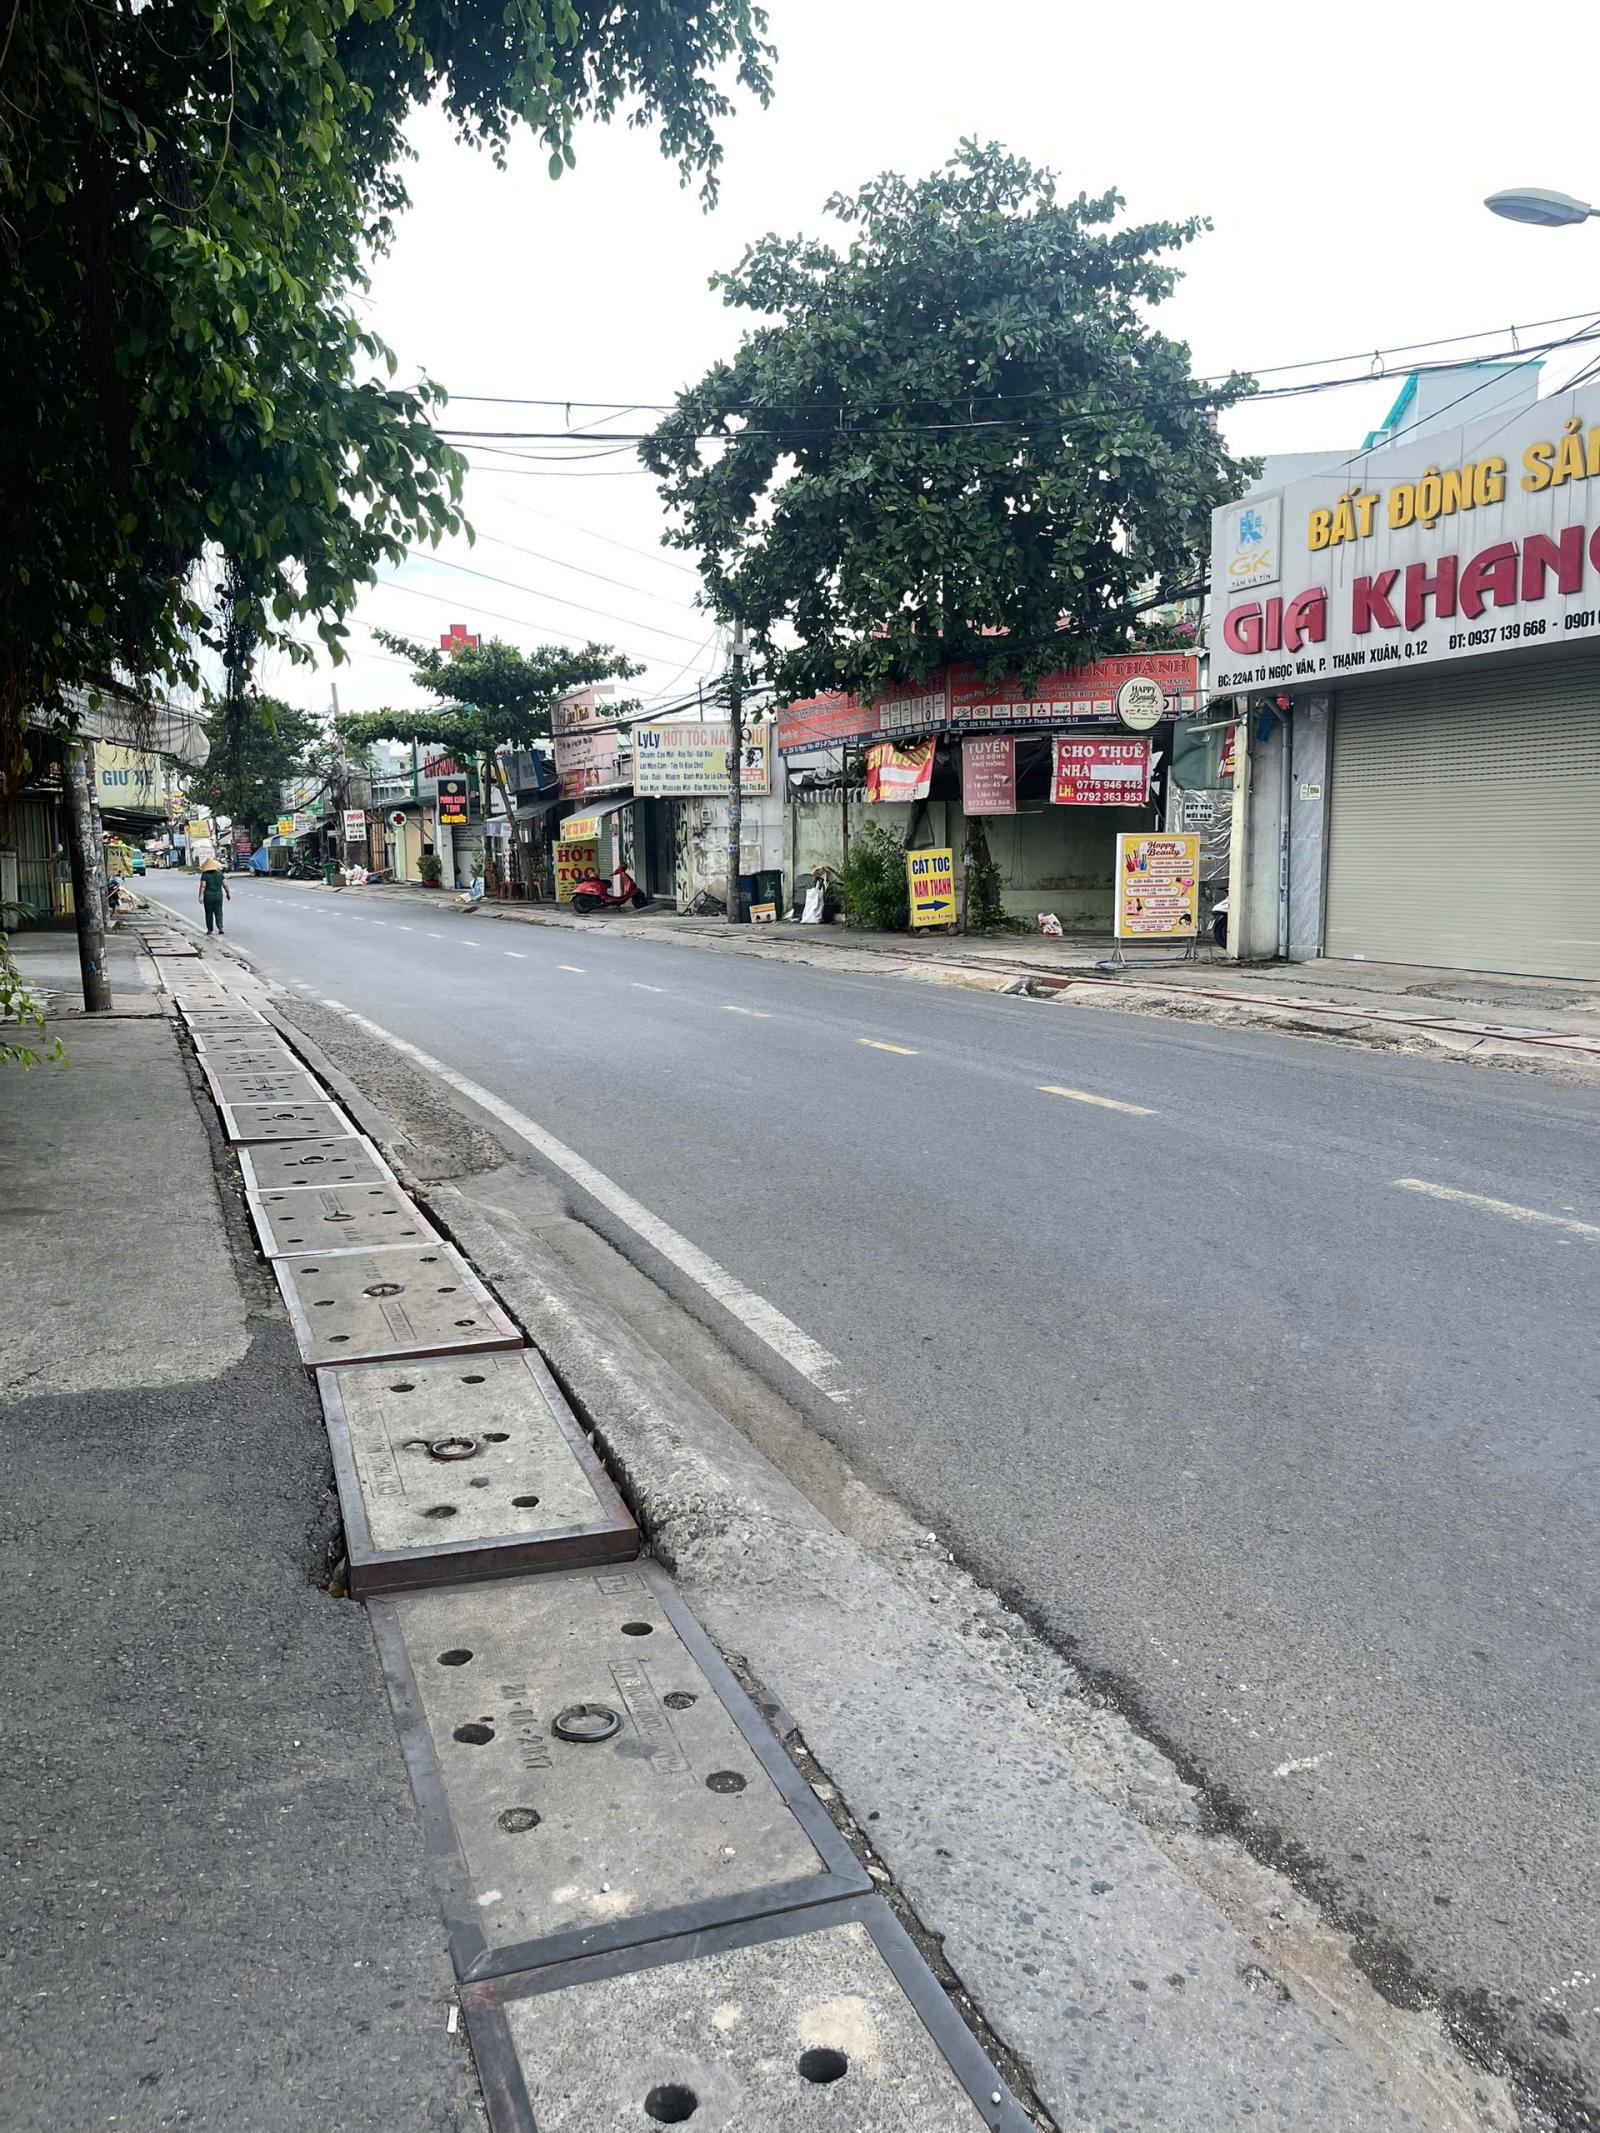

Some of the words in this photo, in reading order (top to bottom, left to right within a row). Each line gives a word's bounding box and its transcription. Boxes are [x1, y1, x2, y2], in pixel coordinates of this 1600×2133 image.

[1307, 487, 1381, 551] BẤT
[1387, 457, 1506, 529] ĐỘNG
[1228, 549, 1273, 577] GK
[1223, 586, 1329, 656] GIA
[1352, 524, 1600, 634] KHAN
[1449, 633, 1466, 650] ĐT:
[1467, 627, 1497, 647] 0937
[1499, 623, 1521, 641] 139
[1523, 618, 1547, 637] 668
[1564, 609, 1596, 631] 0901
[1112, 656, 1190, 675] THÀNH
[1217, 674, 1232, 688] ĐC:
[1232, 671, 1254, 686] 224A
[1255, 664, 1266, 682] TÔ
[1268, 662, 1293, 681] NGỌC
[1295, 657, 1317, 676] VÂN,
[1318, 657, 1327, 672] P.
[1332, 650, 1366, 671] THẠNH
[1369, 644, 1402, 664] XUÂN,
[1404, 640, 1428, 659] Q.12
[1131, 685, 1156, 694] HAPPY
[1128, 692, 1158, 705] Beauty
[637, 730, 660, 748] LyLy
[663, 727, 685, 746] HỚT
[688, 726, 707, 746] TÓC
[967, 738, 1010, 754] TUYỂN
[1061, 745, 1096, 758] CHO
[1098, 742, 1144, 758] THUÊ
[1061, 761, 1090, 777] NHÀ
[1058, 784, 1074, 797] LH:
[1076, 792, 1101, 802] 0792
[1103, 792, 1122, 802] 363
[1123, 792, 1143, 802] 953
[1076, 780, 1101, 790] 0775
[1103, 780, 1122, 790] 946
[1124, 780, 1143, 790] 442
[1147, 841, 1177, 849] Happy
[557, 846, 596, 862] HỚT
